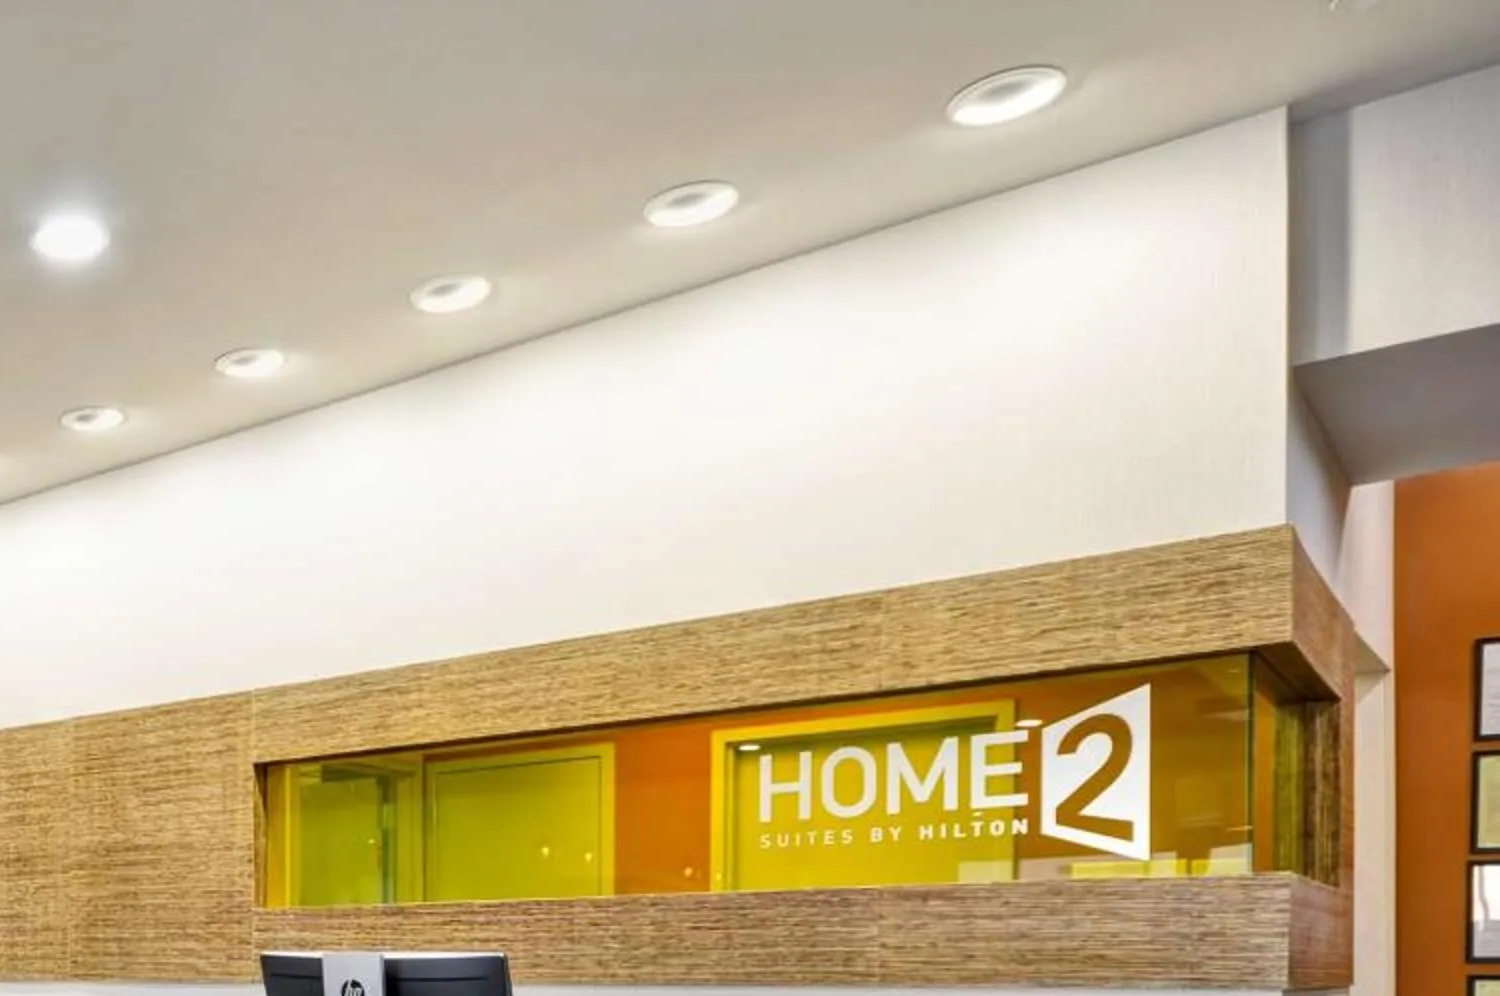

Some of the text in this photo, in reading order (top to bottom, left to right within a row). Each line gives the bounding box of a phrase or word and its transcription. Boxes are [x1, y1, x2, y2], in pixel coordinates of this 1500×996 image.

[760, 817, 1029, 849] SUITES BY HILTON
